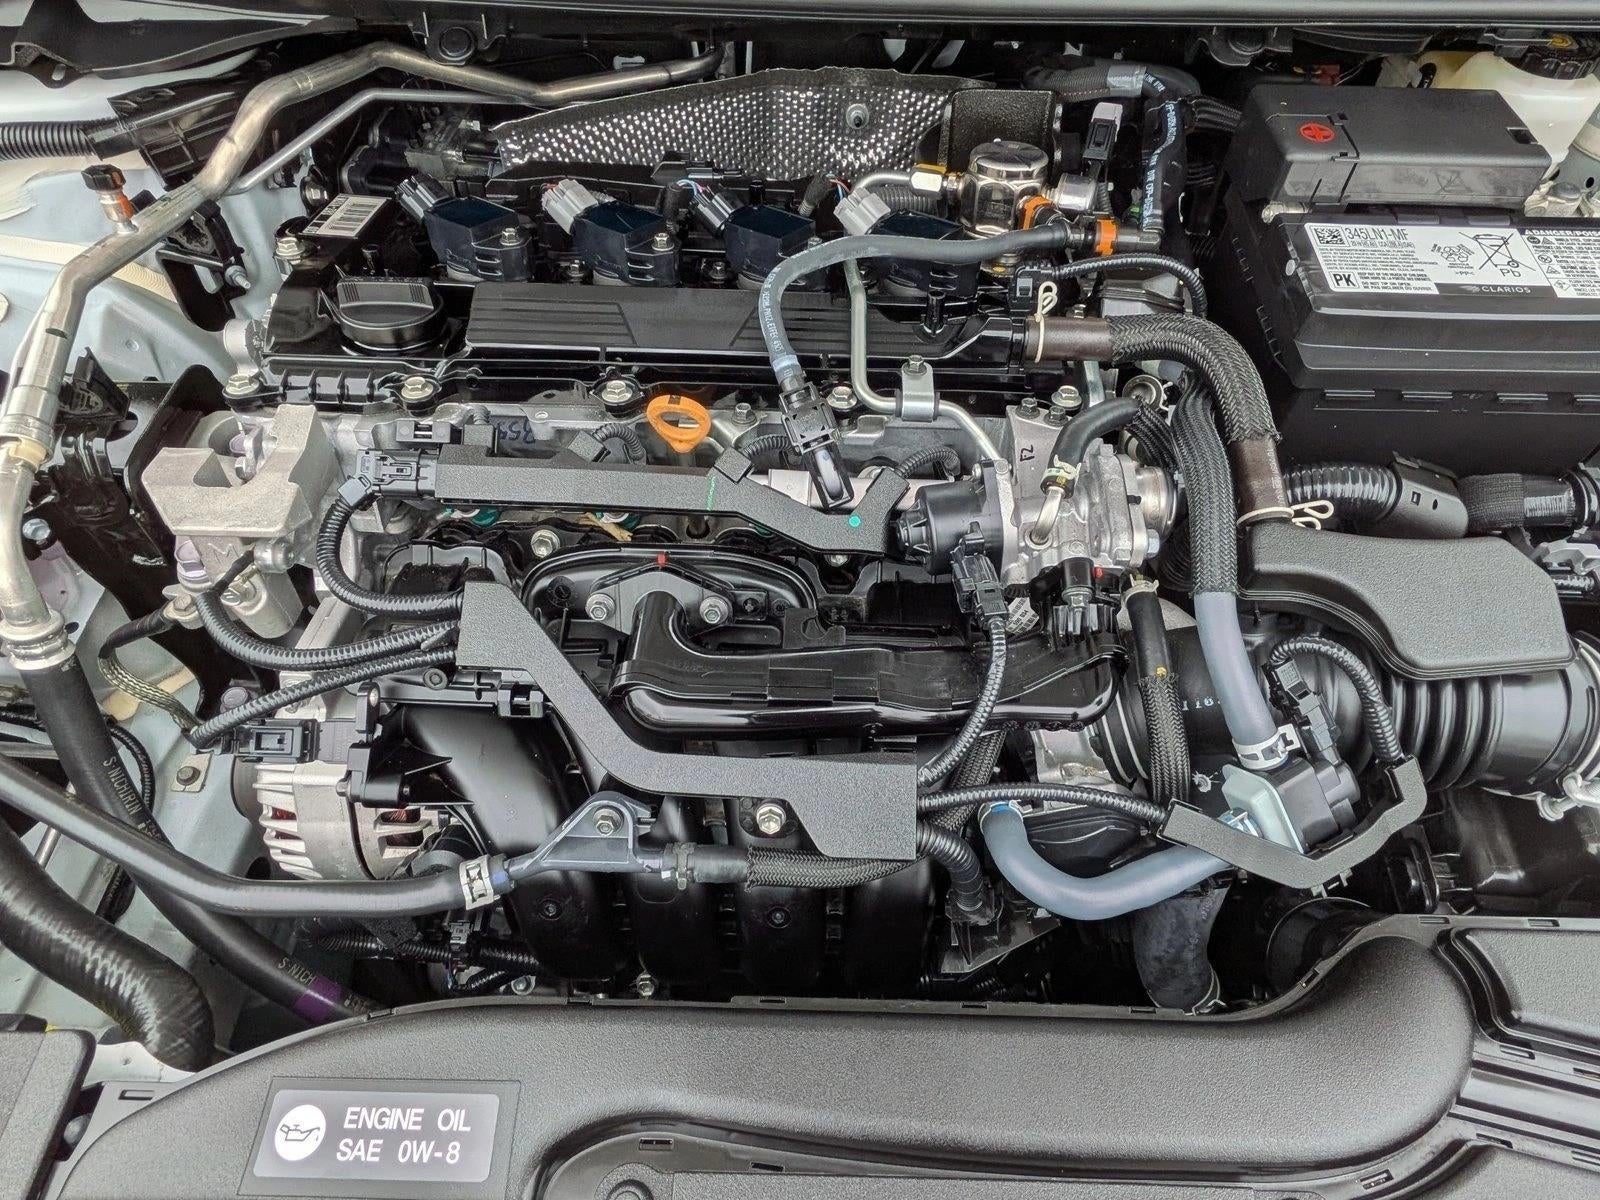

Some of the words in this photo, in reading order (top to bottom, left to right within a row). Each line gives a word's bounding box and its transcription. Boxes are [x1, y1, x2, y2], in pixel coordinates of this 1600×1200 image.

[1344, 227, 1410, 241] 345LN1-MF
[1332, 273, 1356, 287] PK
[1500, 268, 1522, 278] Pb
[1481, 286, 1532, 294] CLARIOS
[343, 1107, 425, 1130] ENGINE
[437, 1108, 472, 1132] OIL
[336, 1138, 384, 1162] SAE
[398, 1140, 461, 1164] 0W-8
